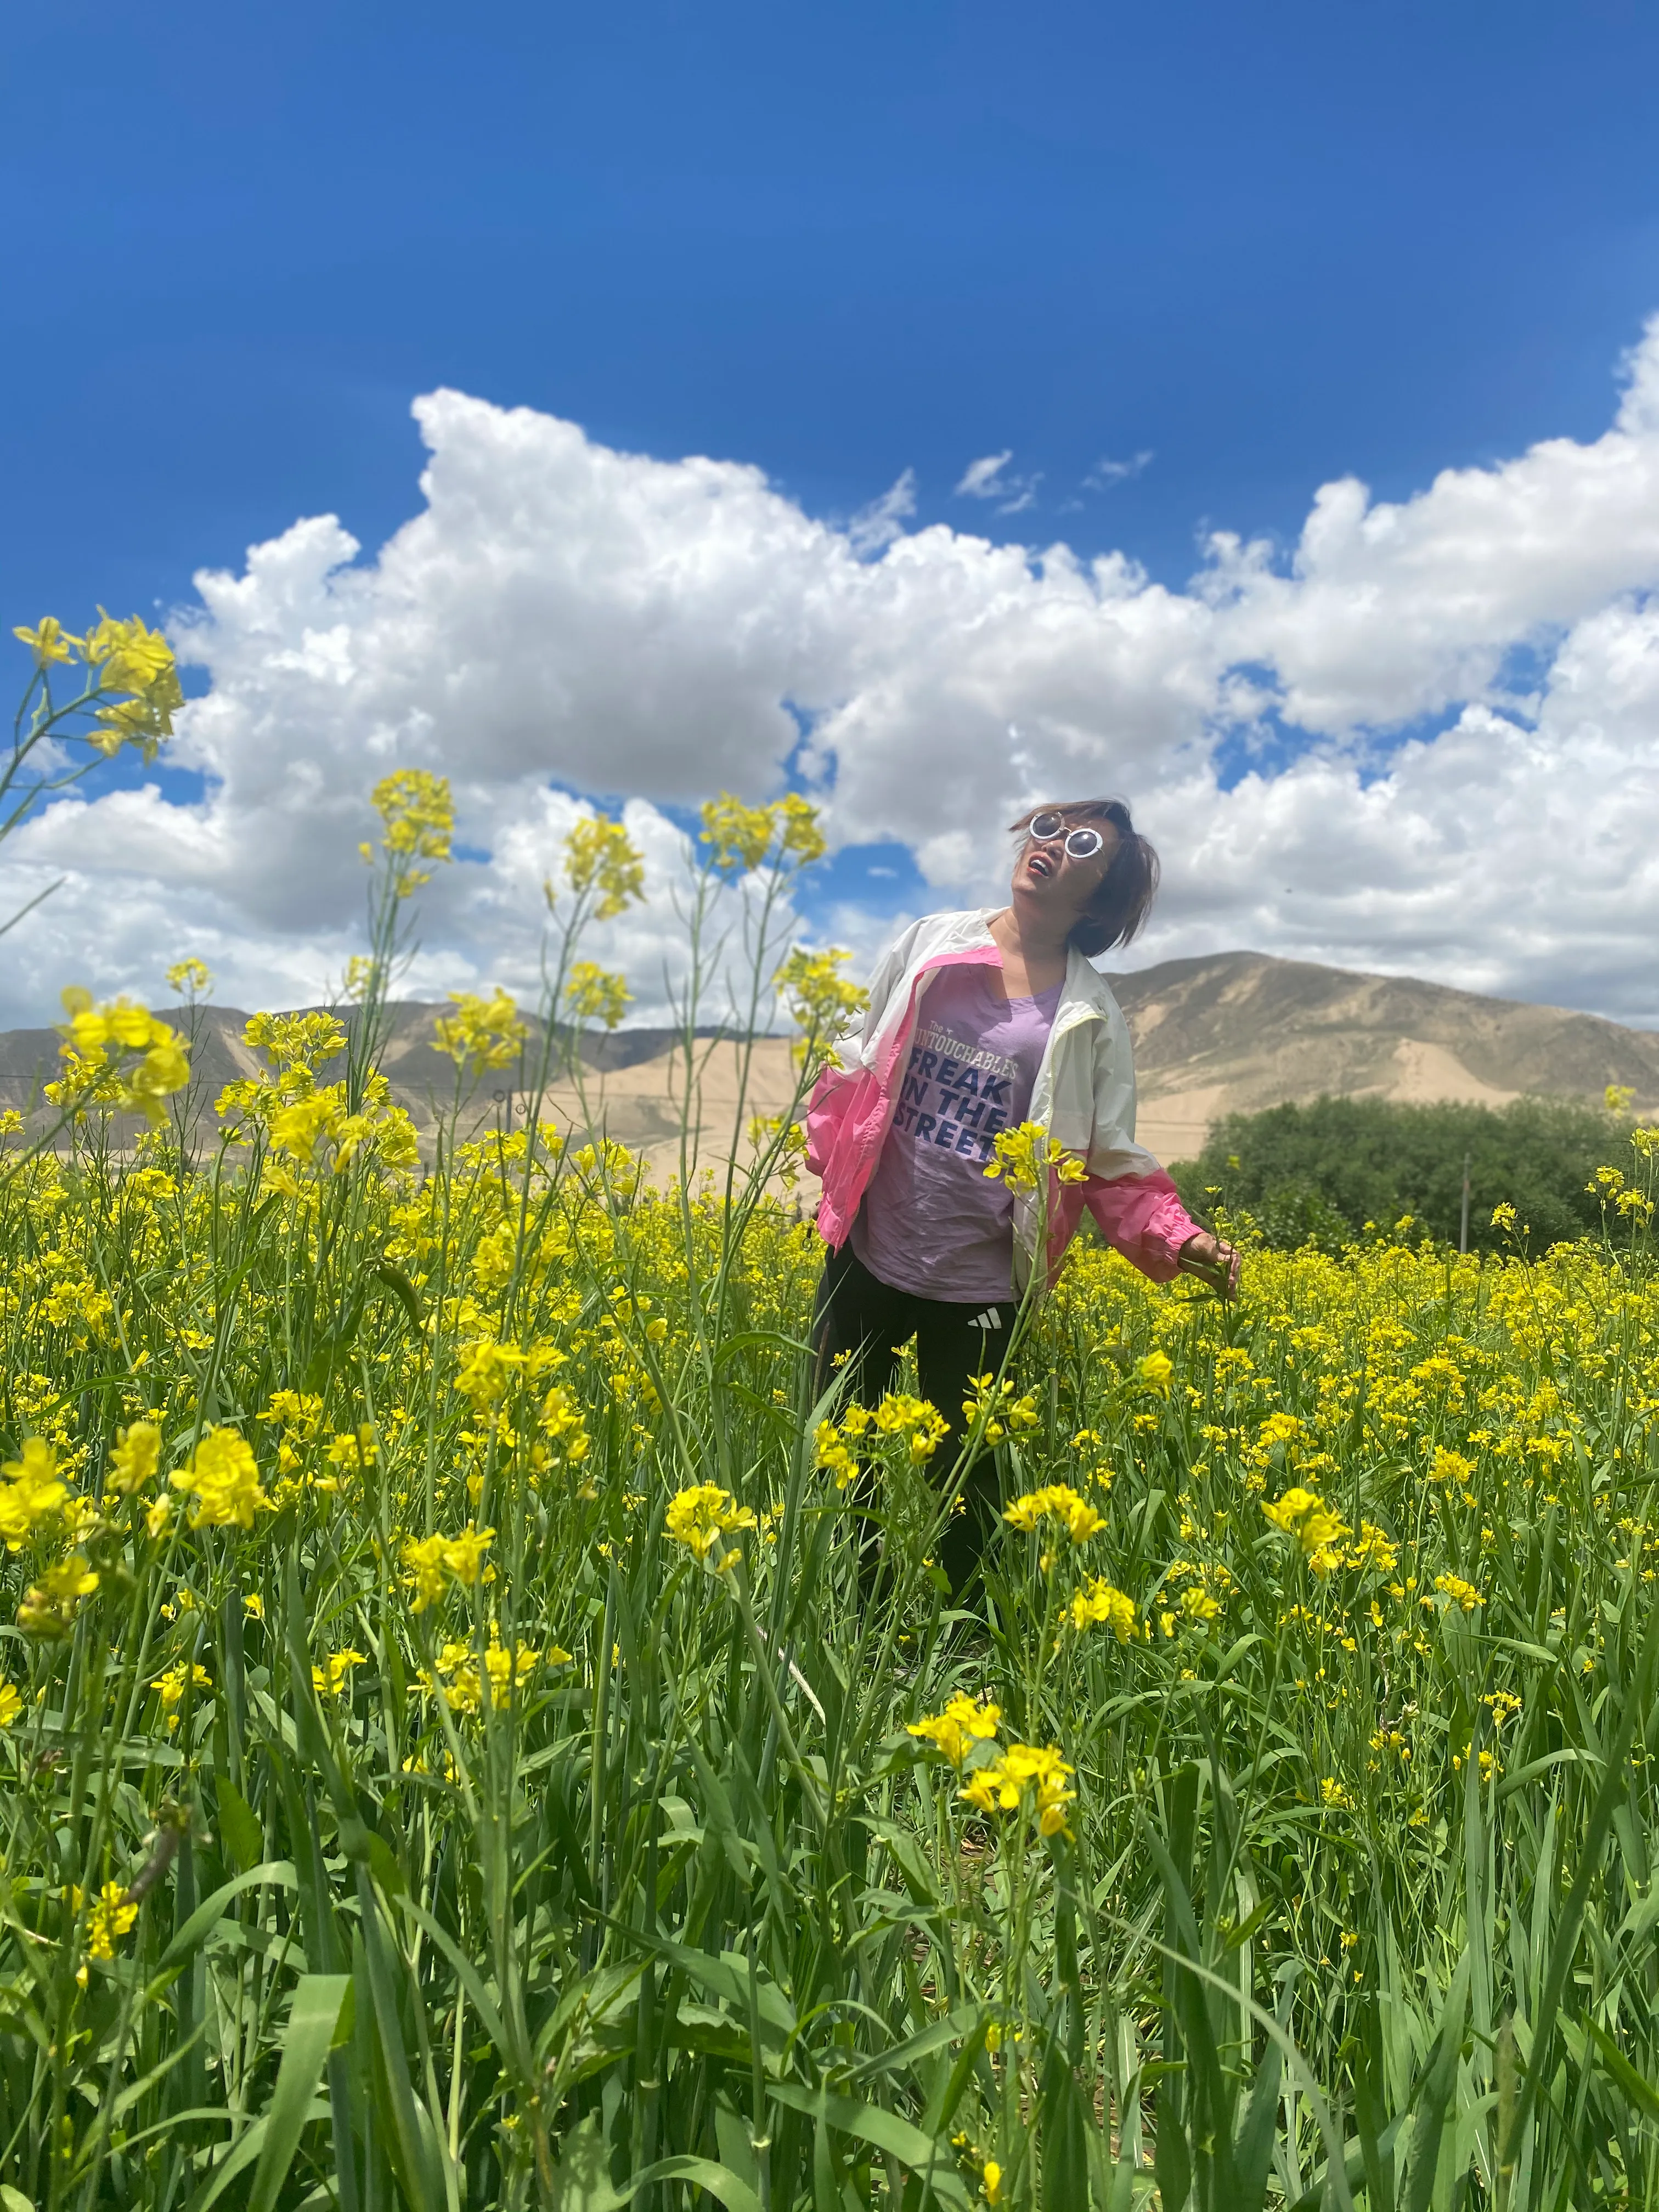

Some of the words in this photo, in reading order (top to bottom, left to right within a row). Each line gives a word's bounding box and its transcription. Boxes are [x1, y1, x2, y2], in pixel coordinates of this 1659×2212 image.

[929, 1020, 944, 1033] The
[908, 1047, 1012, 1106] FREAK
[915, 1028, 1019, 1079] UNTOUCHABLES
[893, 1102, 995, 1161] STREET
[937, 1088, 1008, 1134] THE
